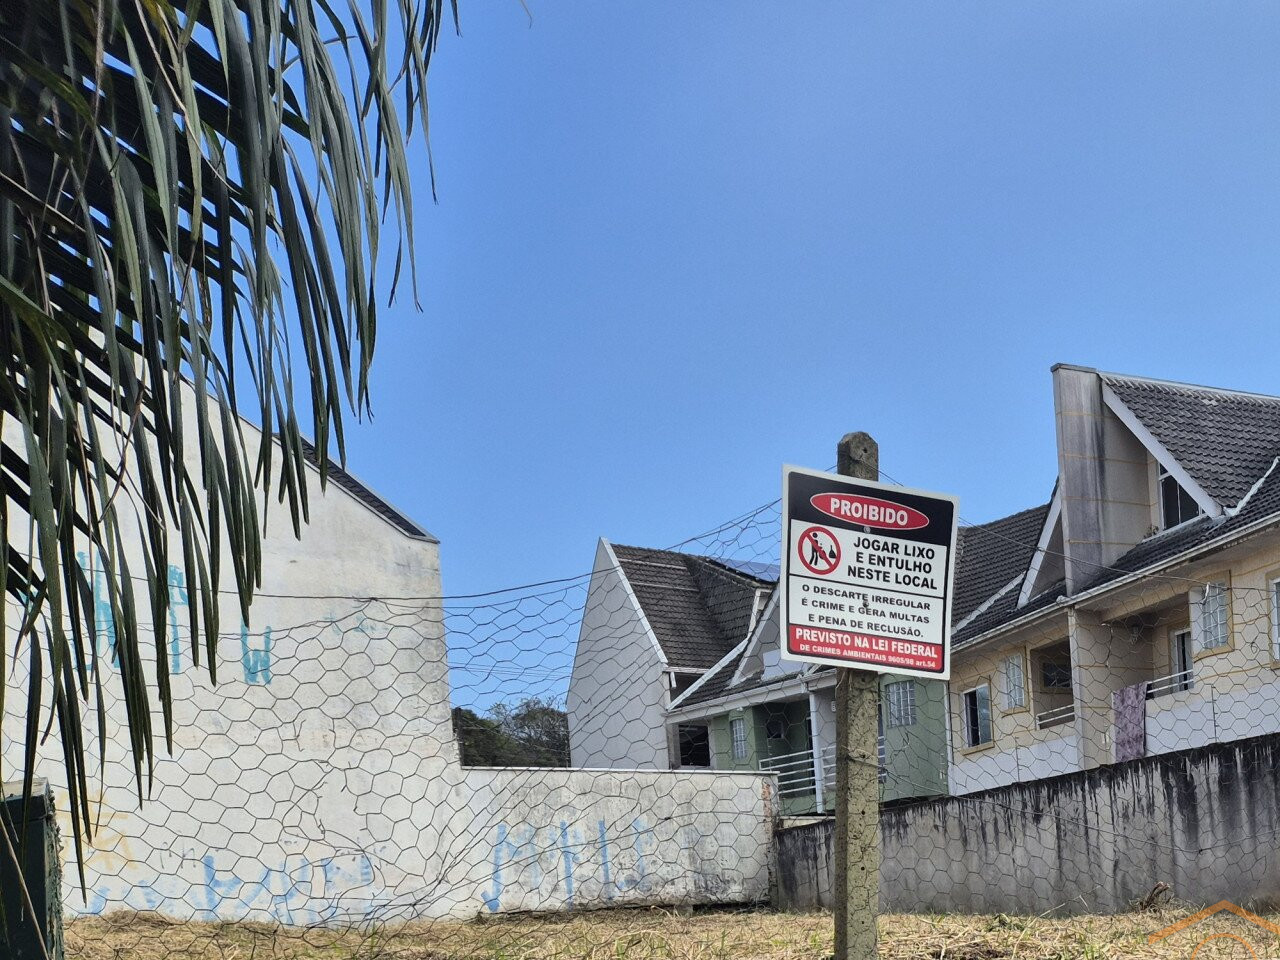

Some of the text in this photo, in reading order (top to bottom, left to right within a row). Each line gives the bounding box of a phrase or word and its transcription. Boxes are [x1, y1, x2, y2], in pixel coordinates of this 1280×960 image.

[830, 497, 908, 526] PROIBIDO
[853, 536, 935, 560] JOGAR LIXO
[856, 551, 932, 574] E ENTULHO
[847, 565, 938, 590] NESTE LOCAL
[802, 584, 931, 610] O DESCARTE IRREGULAR
[801, 598, 930, 624] É CRIME E GERA MULTAS
[808, 613, 815, 622] E
[818, 615, 847, 627] PENA
[850, 620, 864, 629] DE
[795, 627, 938, 658] PREVISTO NA LEI FEDERAL
[799, 644, 811, 652] DE
[812, 645, 841, 655] CRIMES
[842, 649, 887, 662] AMBIENTAIS
